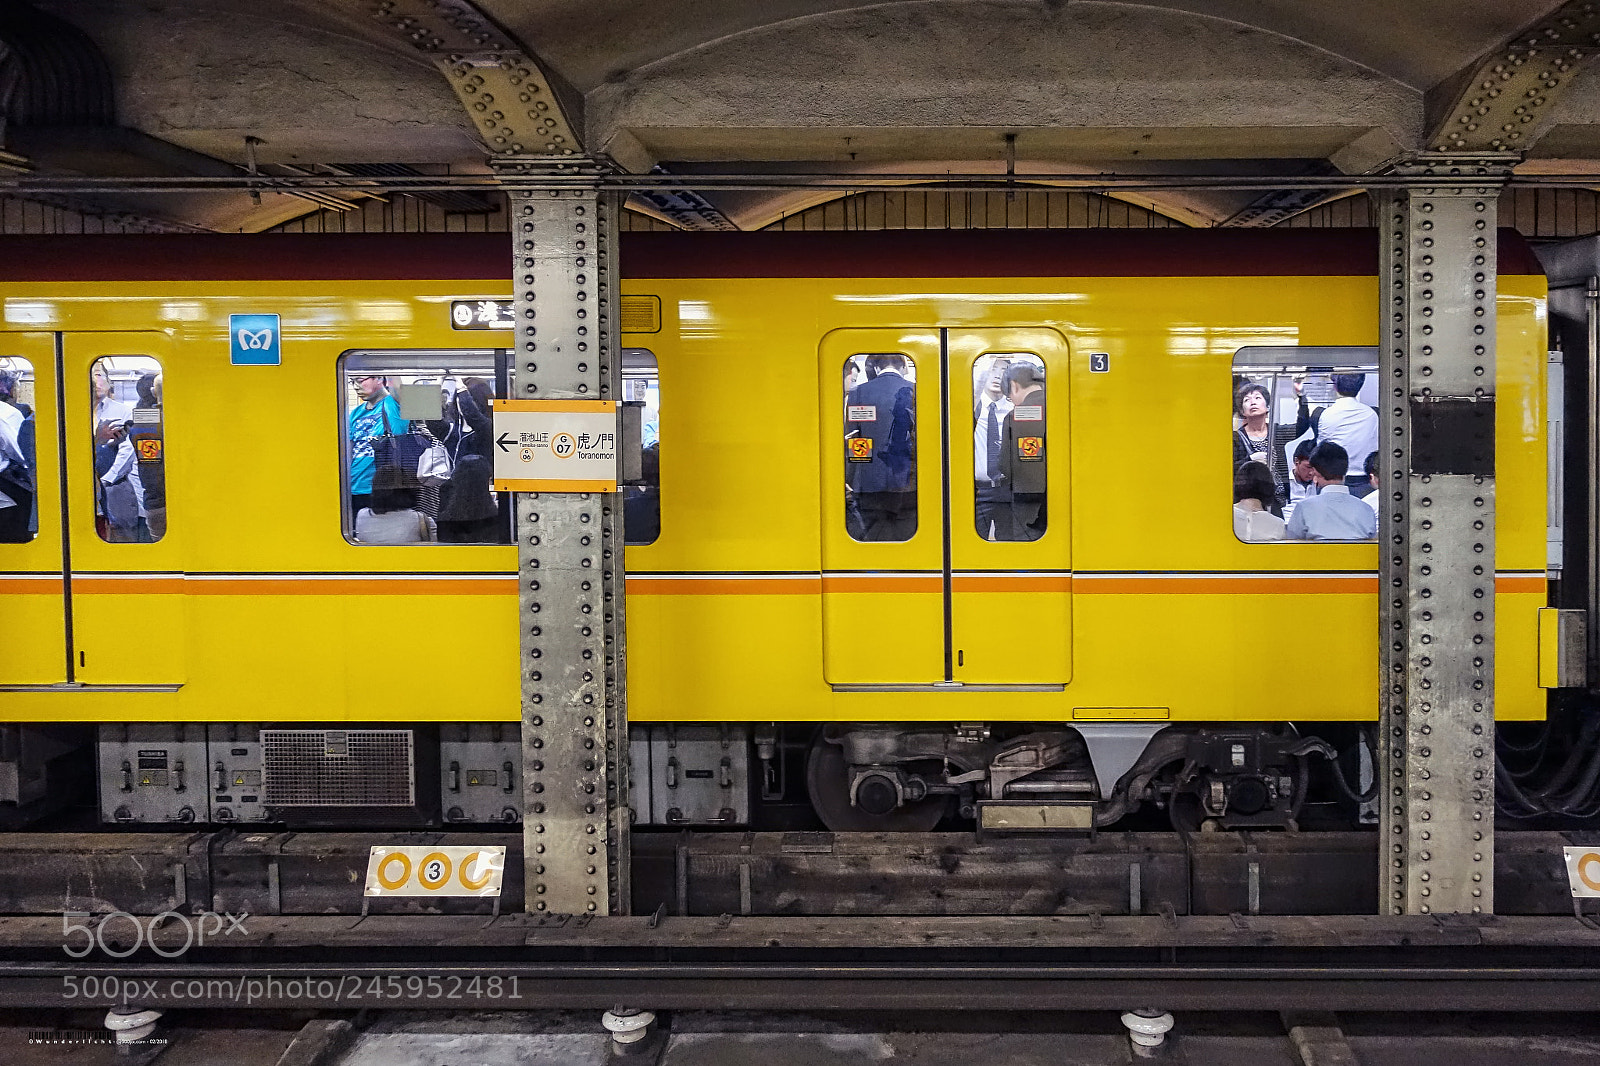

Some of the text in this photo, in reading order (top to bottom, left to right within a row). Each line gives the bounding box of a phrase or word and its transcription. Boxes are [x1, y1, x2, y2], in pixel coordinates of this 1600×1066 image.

[1095, 355, 1104, 370] 3
[560, 435, 568, 443] G
[577, 432, 614, 450] 虎ノ門
[556, 445, 572, 454] 07
[577, 451, 615, 460] Toranomon
[428, 862, 441, 881] 3
